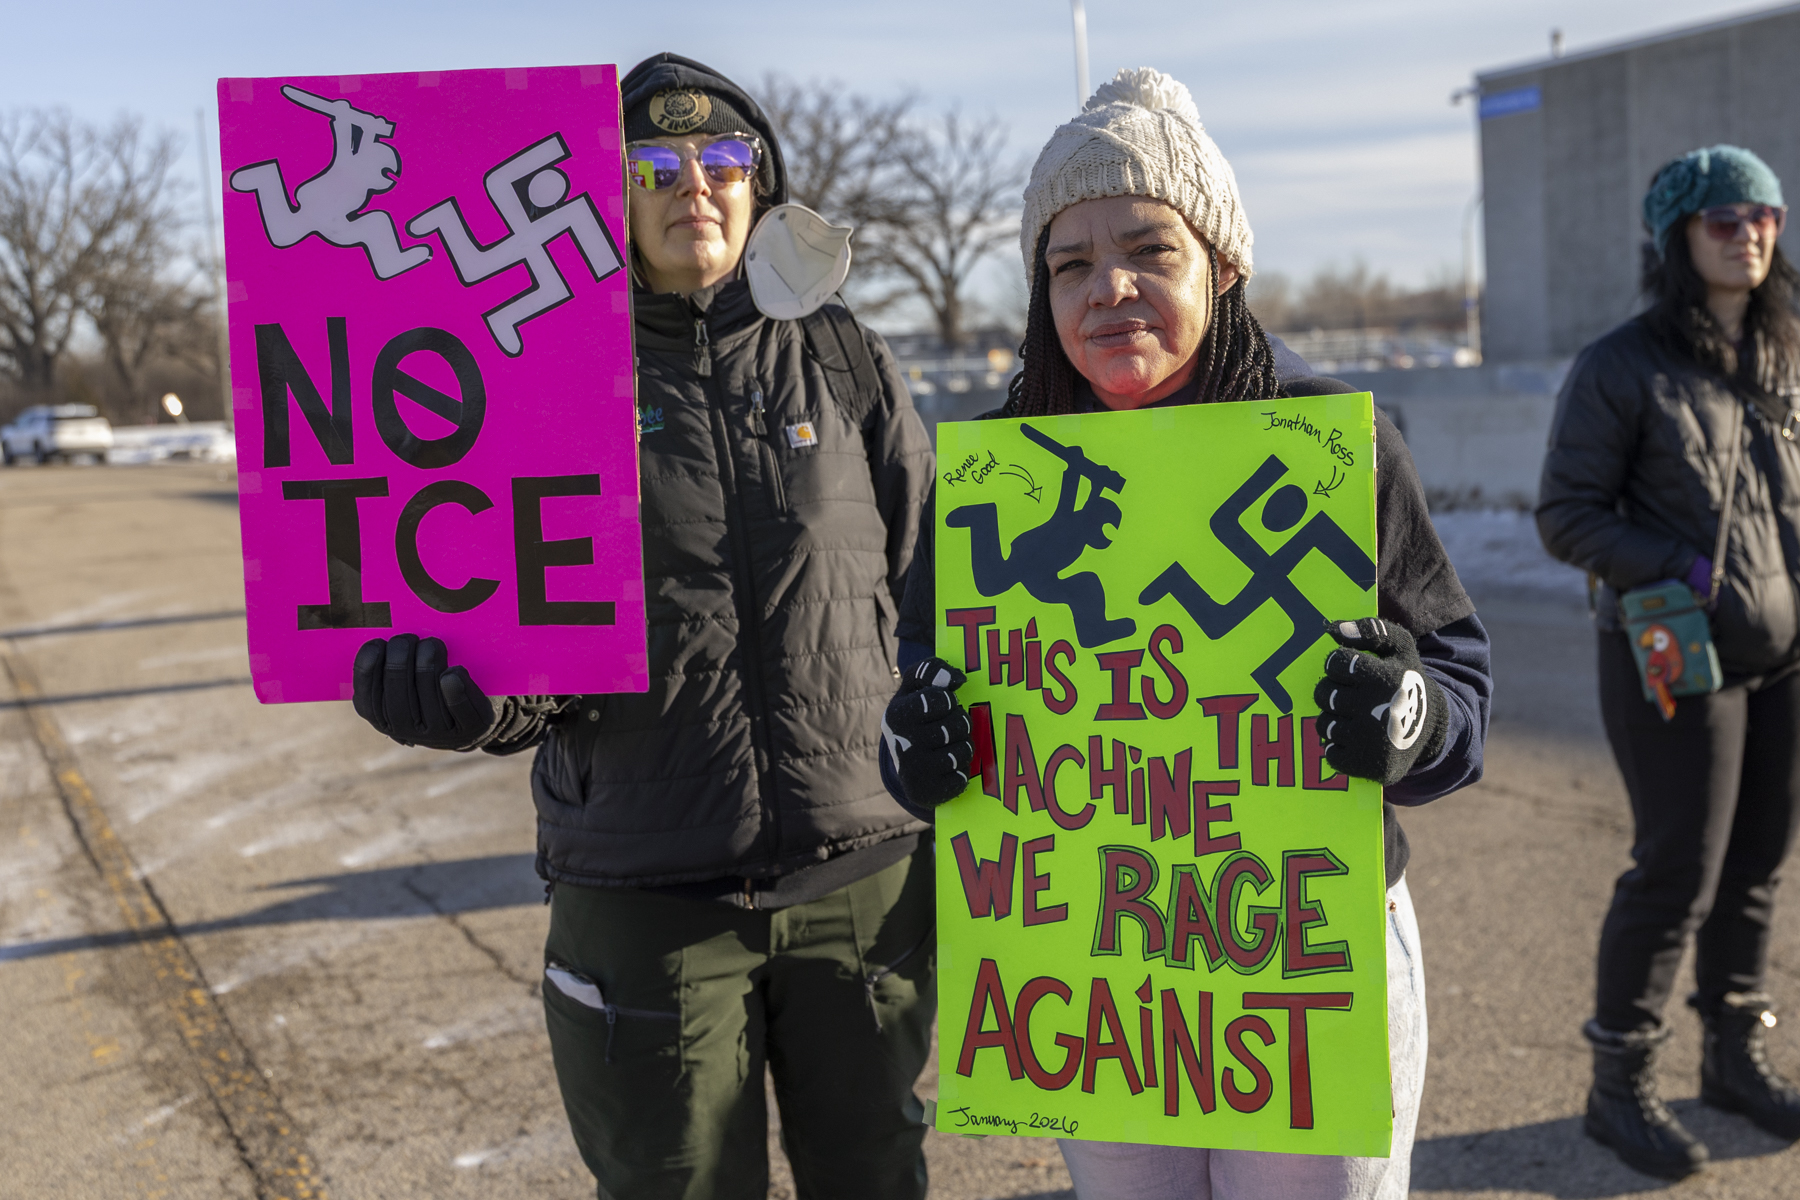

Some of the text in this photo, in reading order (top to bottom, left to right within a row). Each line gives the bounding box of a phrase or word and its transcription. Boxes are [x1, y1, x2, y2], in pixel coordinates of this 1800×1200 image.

[657, 113, 705, 131] TIMES
[254, 316, 487, 469] NO
[1260, 411, 1354, 466] Jonathan Ross
[943, 452, 979, 487] Renee
[971, 449, 1000, 484] Good
[281, 473, 616, 631] ICE
[1093, 624, 1189, 721] IS
[1196, 693, 1349, 792] THE
[950, 830, 1353, 979] WE RAGE
[947, 1106, 1079, 1136] January 2026
